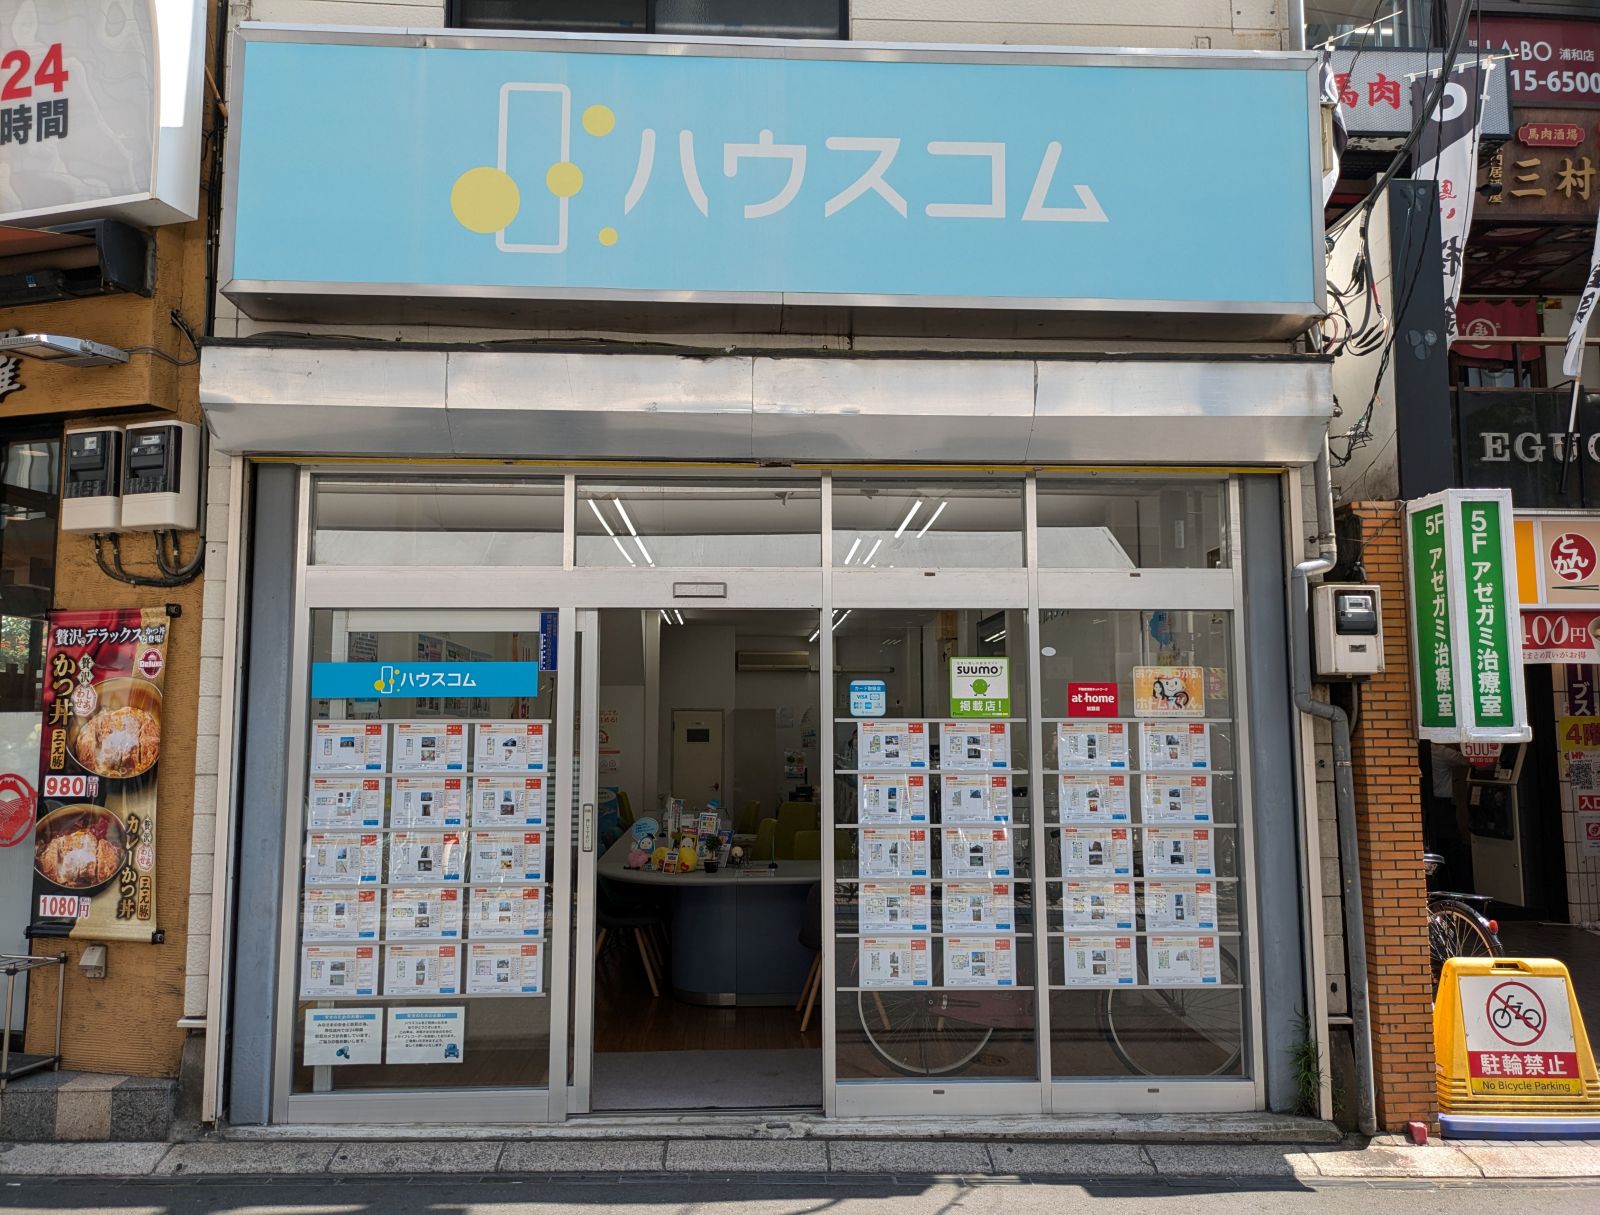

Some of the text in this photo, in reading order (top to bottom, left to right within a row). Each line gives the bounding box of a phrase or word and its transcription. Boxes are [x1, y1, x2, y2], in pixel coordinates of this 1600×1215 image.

[0, 43, 69, 100] 24
[1559, 48, 1595, 62] 浦和店
[0, 97, 69, 146] 時間
[1527, 127, 1578, 141] 馬肉酒場
[624, 127, 1110, 223] ハウスコム
[1510, 156, 1597, 202] 三村
[1471, 510, 1487, 555] 5F
[1425, 512, 1454, 717] 5F アゼガミ治療室
[1471, 562, 1504, 717] アゼガミ治療室
[48, 653, 76, 726] かつ丼
[400, 672, 476, 688] ハウスコム
[51, 731, 66, 769] 三元豚
[119, 815, 139, 919] カレーかつ丼
[1480, 1053, 1568, 1076] 駐輪禁止
[1482, 1081, 1571, 1092] No Bicycle Parking
